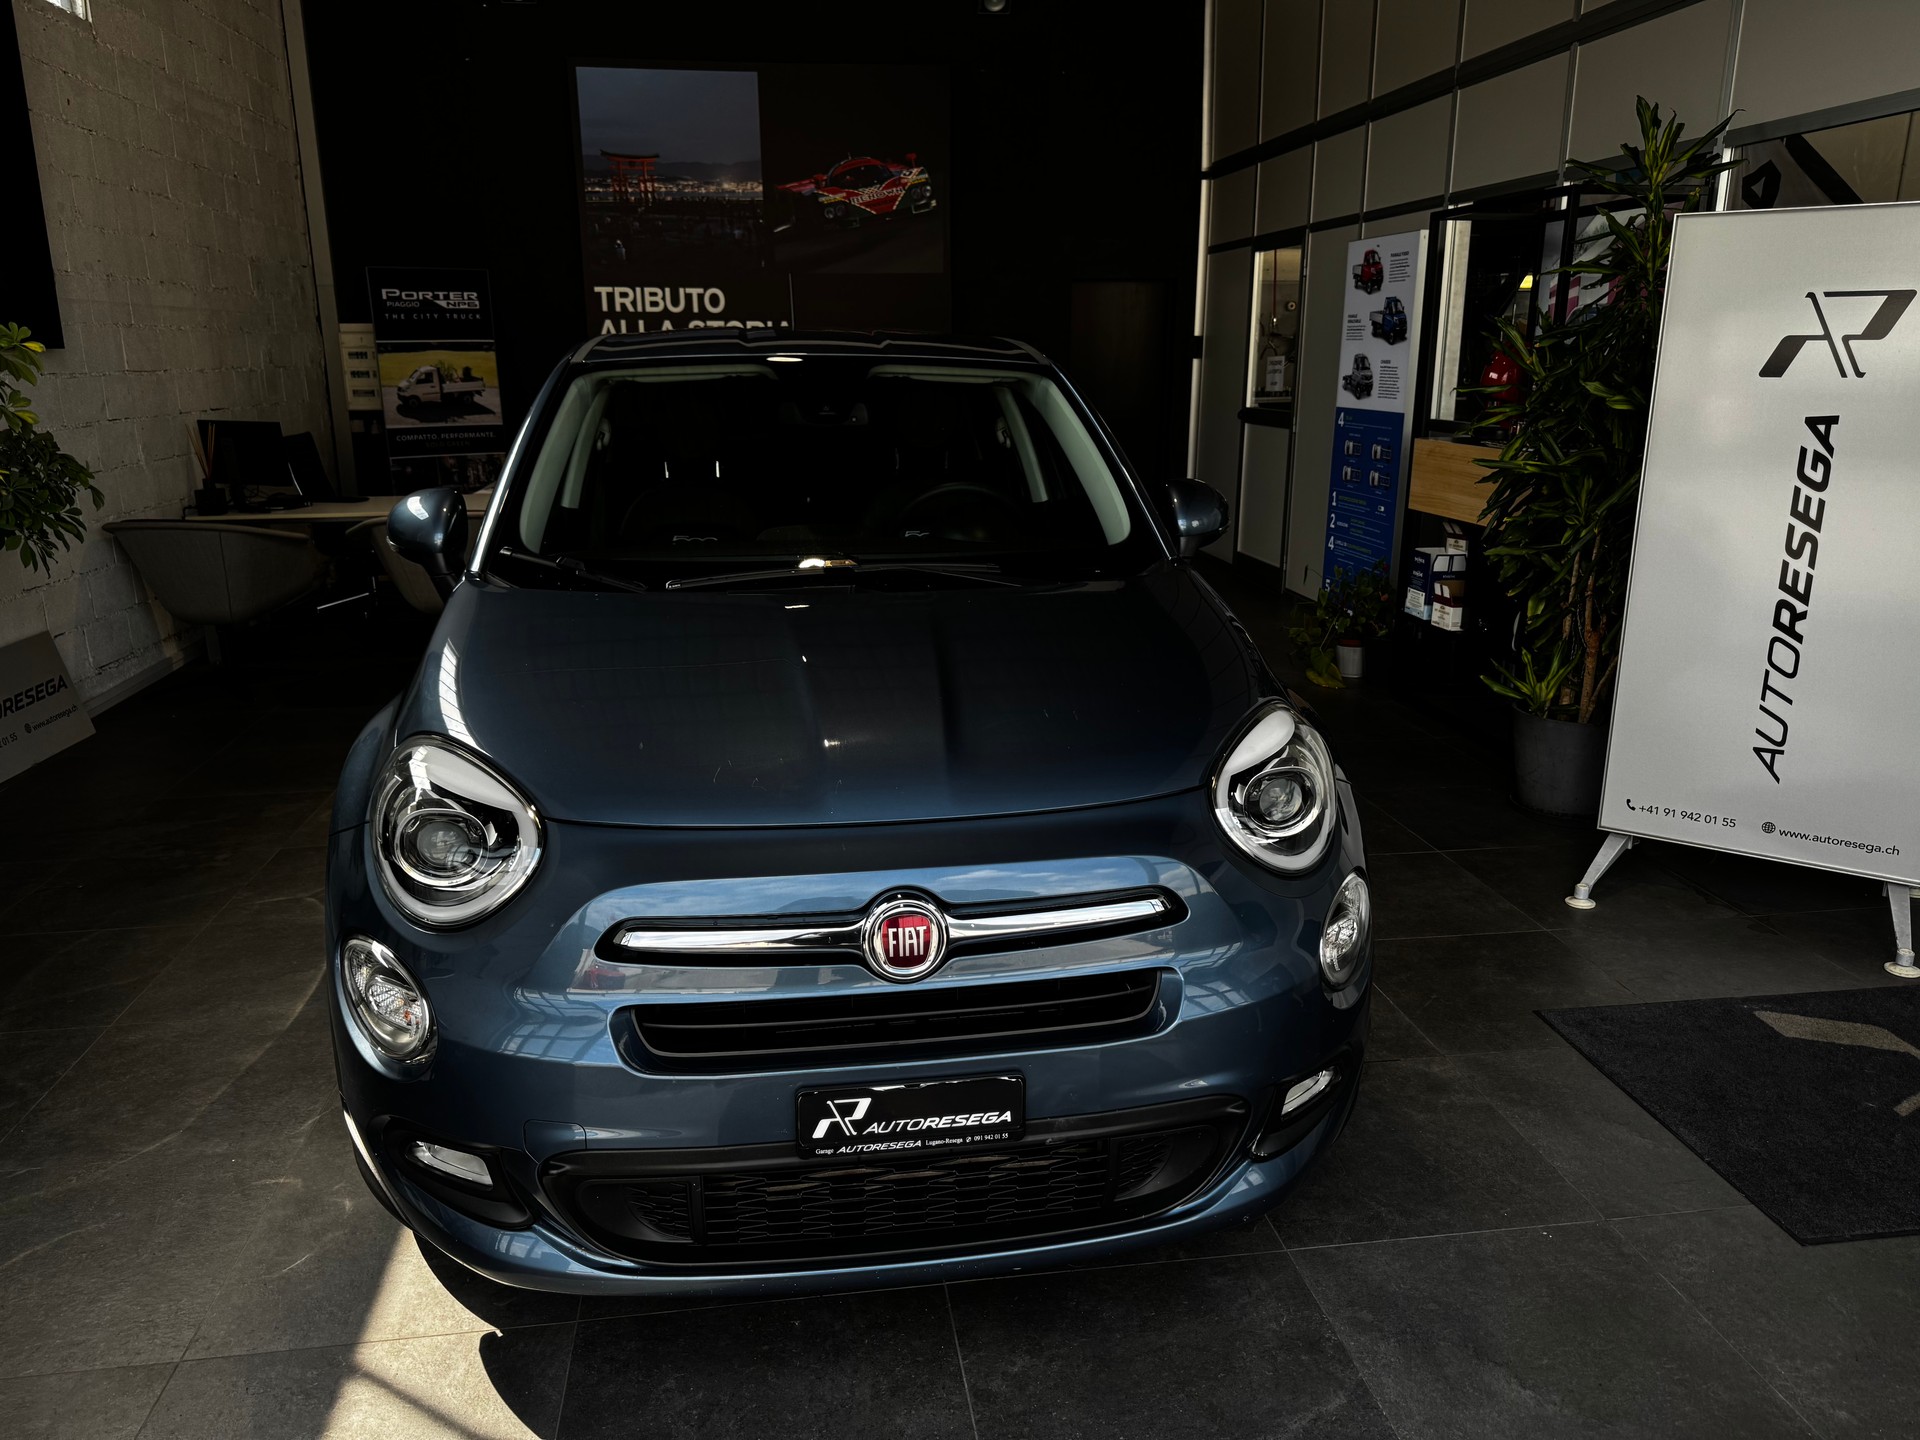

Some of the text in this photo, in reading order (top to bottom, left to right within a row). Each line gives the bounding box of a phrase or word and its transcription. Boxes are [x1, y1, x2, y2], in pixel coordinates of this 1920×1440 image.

[381, 288, 478, 301] PORTER
[593, 286, 726, 314] TRIBUTO
[1338, 411, 1344, 427] 4
[1331, 490, 1337, 507] 1
[1329, 513, 1336, 529] 2
[1327, 535, 1335, 551] 4
[1752, 414, 1840, 784] AUTORESEGA
[0, 674, 68, 719] RESEGA
[32, 704, 79, 731] www.autoresega.ch
[1638, 804, 1901, 856] +41 91 942 01 55 www.autoresega.ch
[888, 926, 927, 957] FIAT
[862, 1110, 1012, 1136] AUTORESEGA
[815, 1148, 835, 1156] Garage
[836, 1139, 922, 1155] AUTORESEGA
[1001, 1132, 1009, 1140] 55
